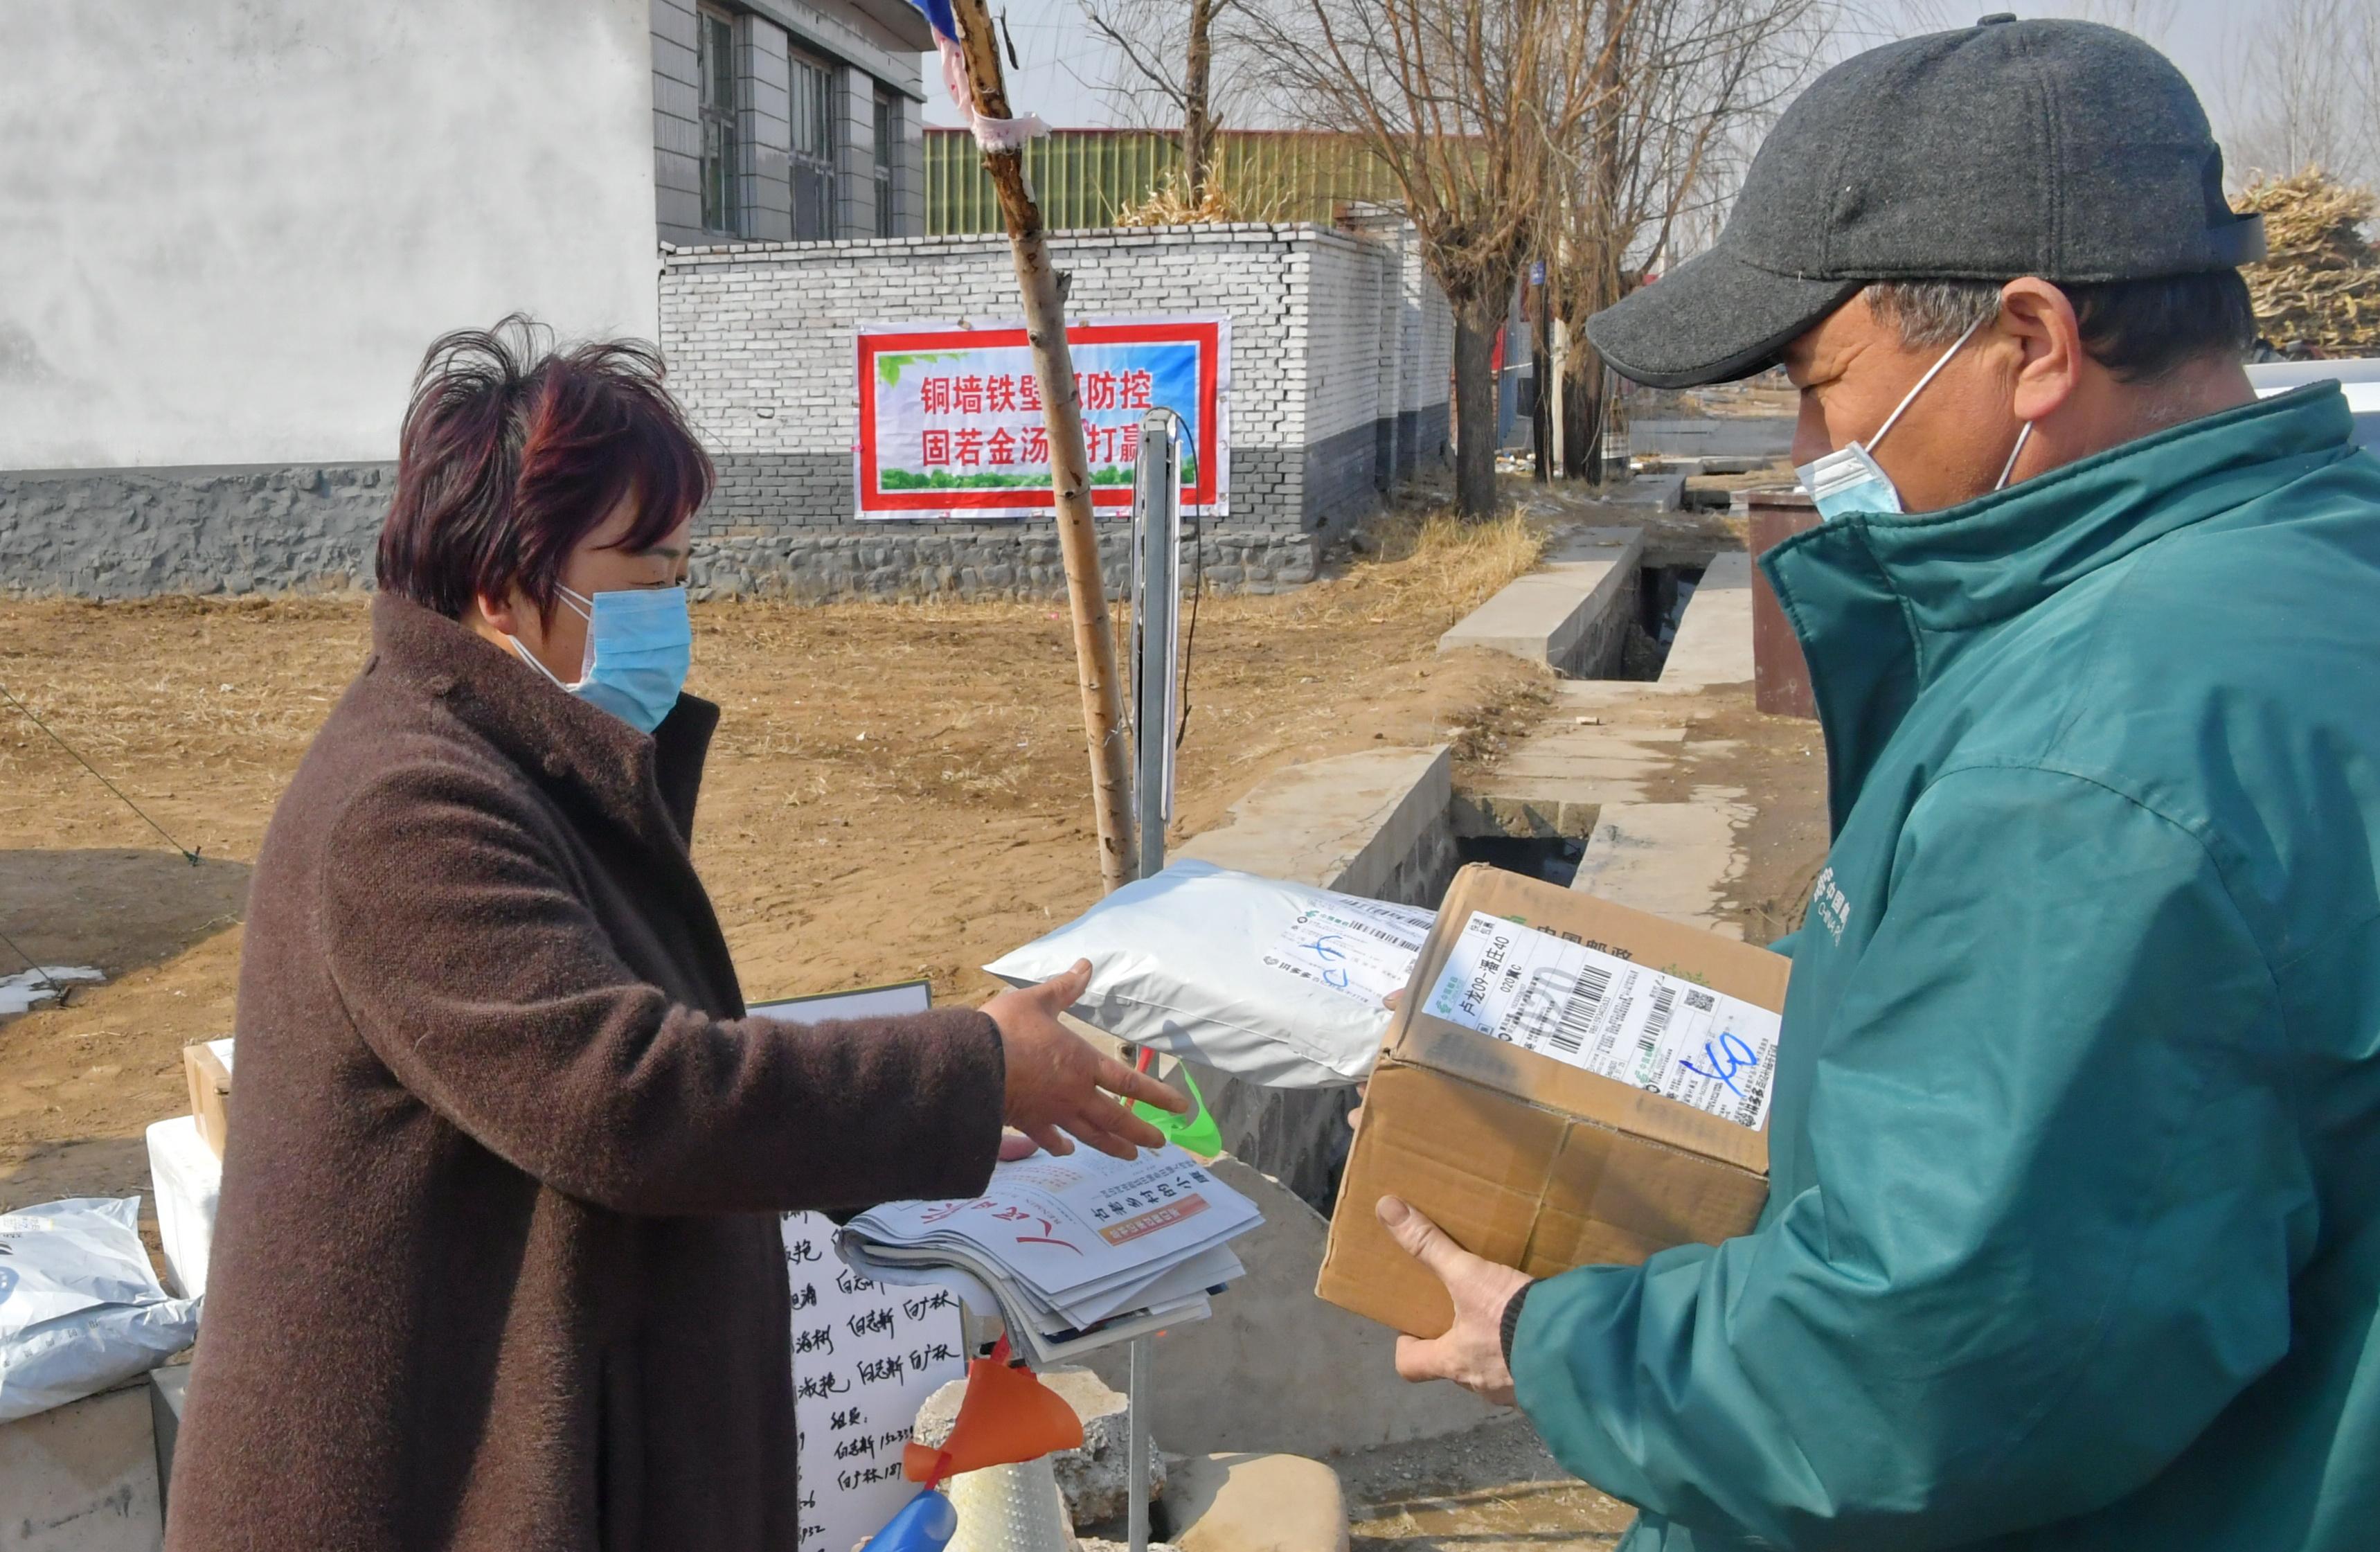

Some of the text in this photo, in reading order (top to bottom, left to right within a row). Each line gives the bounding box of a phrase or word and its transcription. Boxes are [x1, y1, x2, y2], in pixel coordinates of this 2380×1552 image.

[922, 423, 1139, 467] 固若金汤打赢
